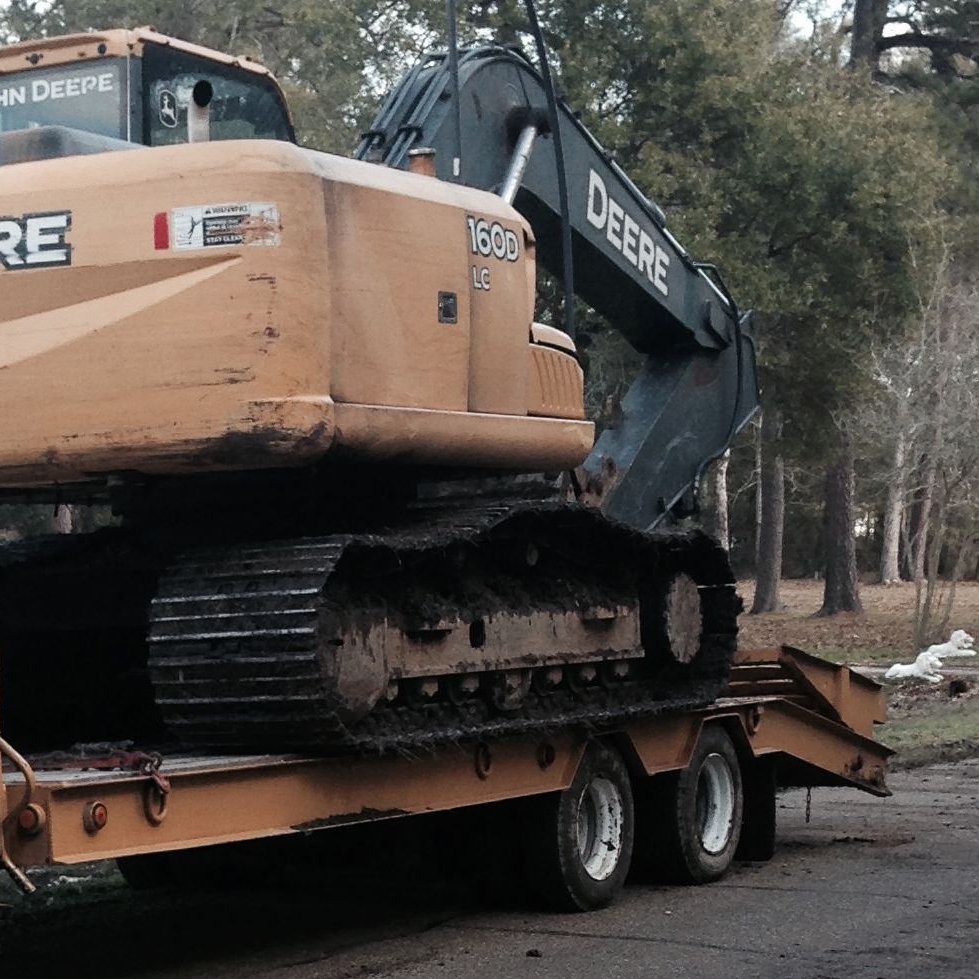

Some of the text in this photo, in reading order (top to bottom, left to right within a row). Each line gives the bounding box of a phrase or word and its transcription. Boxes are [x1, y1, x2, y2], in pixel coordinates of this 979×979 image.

[467, 215, 519, 262] 160D
[586, 168, 670, 296] DEERE
[472, 265, 490, 291] LC
